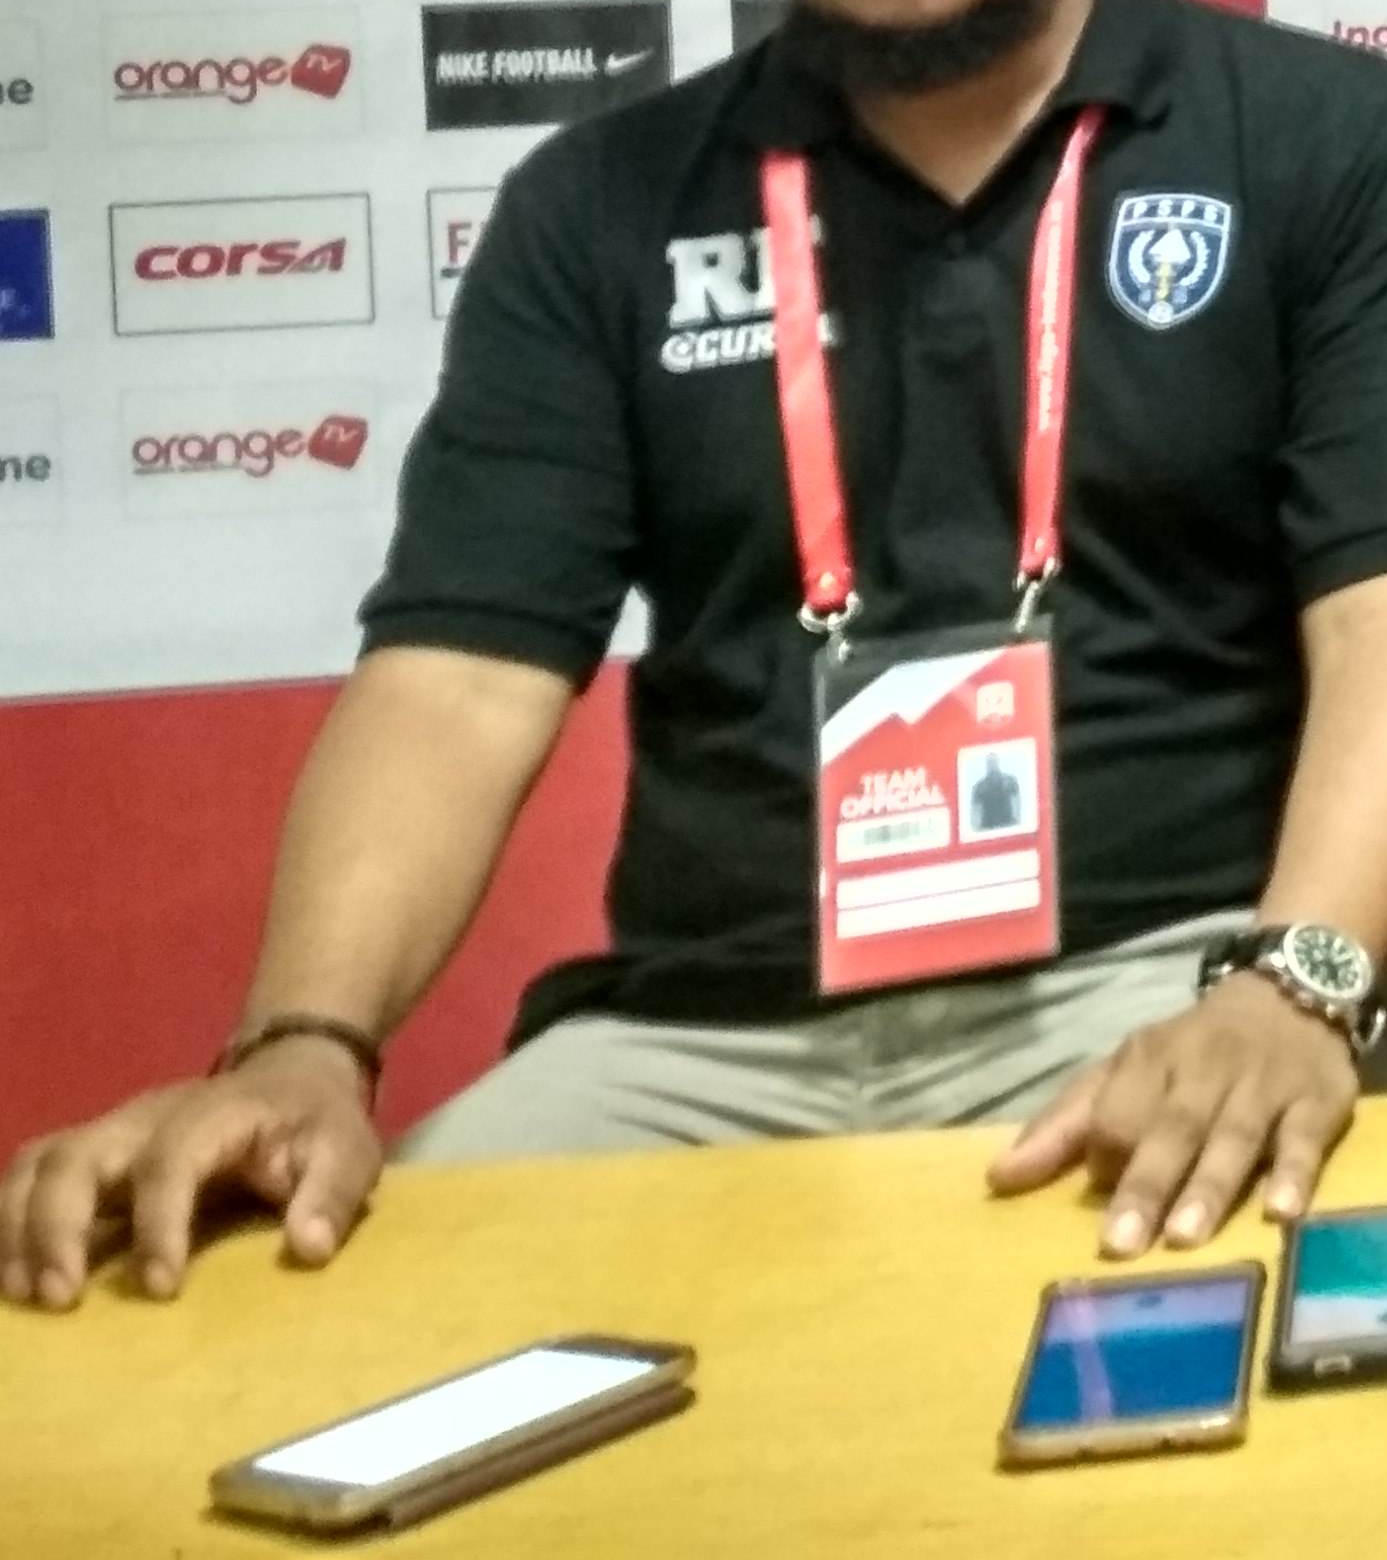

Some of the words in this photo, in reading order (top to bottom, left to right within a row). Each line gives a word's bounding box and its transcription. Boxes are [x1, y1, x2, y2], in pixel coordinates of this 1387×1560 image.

[114, 54, 290, 104] orange
[436, 50, 487, 85] NIKE
[491, 47, 595, 82] FOOTBALL
[1132, 200, 1220, 223] PSPS
[133, 426, 305, 478] orange
[862, 766, 928, 796] TEAM
[840, 785, 945, 820] OFFICIAL
